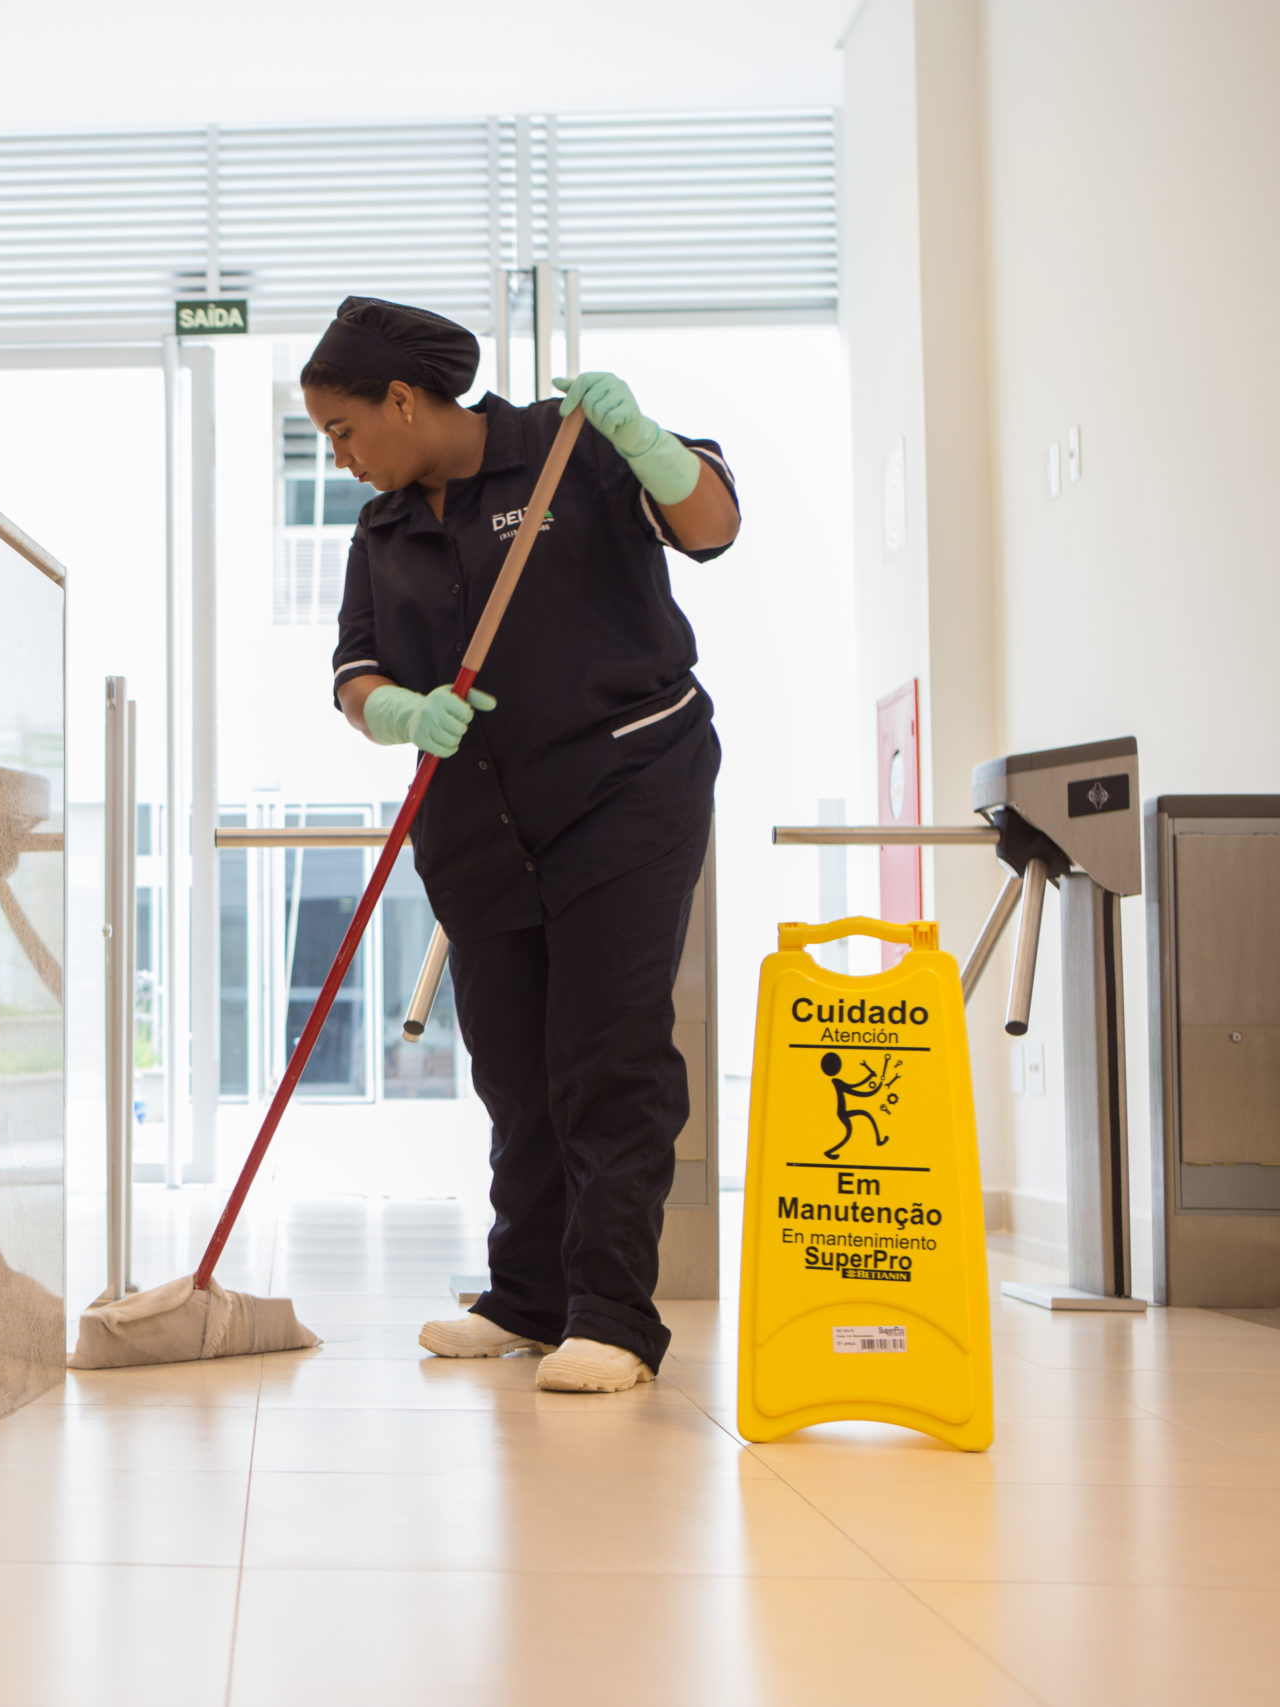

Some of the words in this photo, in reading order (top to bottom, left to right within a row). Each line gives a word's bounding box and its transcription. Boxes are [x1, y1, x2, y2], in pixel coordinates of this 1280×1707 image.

[179, 303, 244, 328] SAÍDA
[791, 997, 929, 1025] Cuidado
[820, 1027, 899, 1044] Atención
[837, 1172, 881, 1196] Em
[778, 1197, 942, 1230] Manutenção
[782, 1228, 804, 1244] En
[810, 1232, 937, 1251] mantenimiento
[805, 1246, 912, 1271] SuperPro
[856, 1269, 908, 1281] BETTANIN
